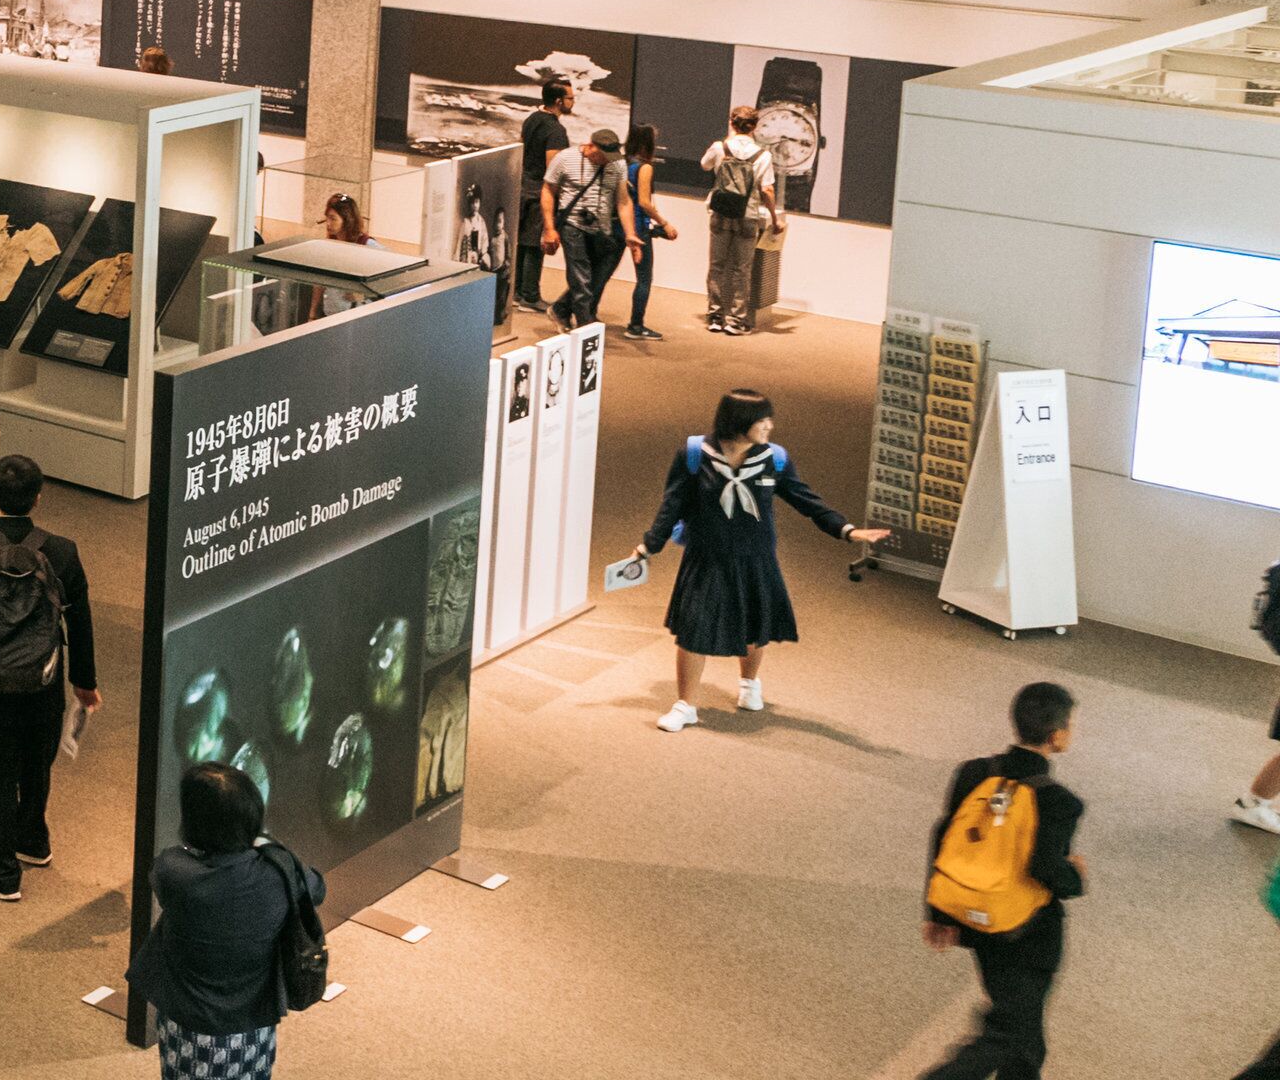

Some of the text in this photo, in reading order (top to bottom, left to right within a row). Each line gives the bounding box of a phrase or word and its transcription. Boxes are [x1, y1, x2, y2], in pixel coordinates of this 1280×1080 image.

[186, 397, 290, 459] 1945年8月6日
[1016, 406, 1051, 424] 入口
[184, 384, 419, 502] 原子爆弾による被害の概要
[1017, 453, 1056, 466] Entrance
[181, 476, 403, 579] Outline of Atomic Bomb Damage
[183, 516, 227, 548] August
